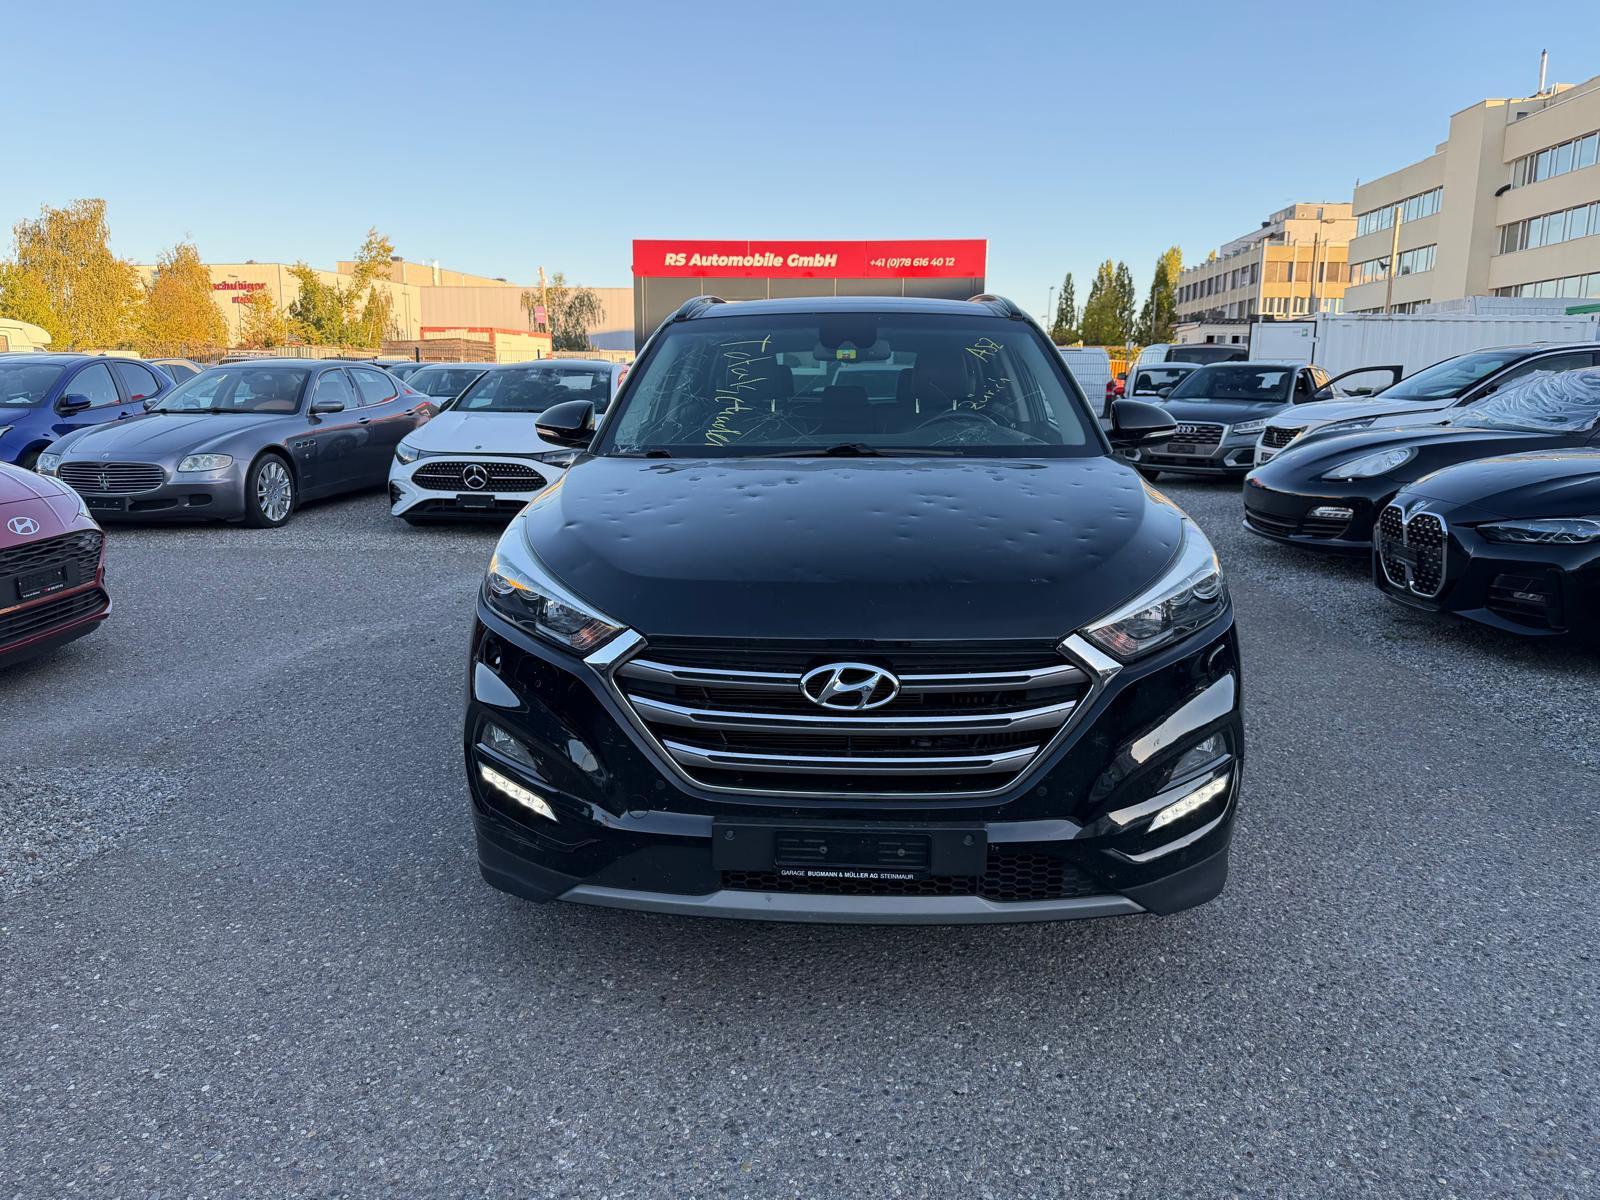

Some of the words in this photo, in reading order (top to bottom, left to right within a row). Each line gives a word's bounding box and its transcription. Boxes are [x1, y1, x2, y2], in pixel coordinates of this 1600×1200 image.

[664, 253, 687, 266] RS
[689, 252, 784, 267] Automobile
[786, 253, 838, 267] GmbH
[869, 258, 886, 267] +41
[886, 257, 911, 268] (0)78
[912, 257, 929, 267] 616
[930, 257, 943, 267] 40
[945, 257, 956, 267] 12
[781, 869, 806, 877] GARAGE
[807, 870, 838, 878] BUGMANN
[844, 870, 869, 879] MÜLLER
